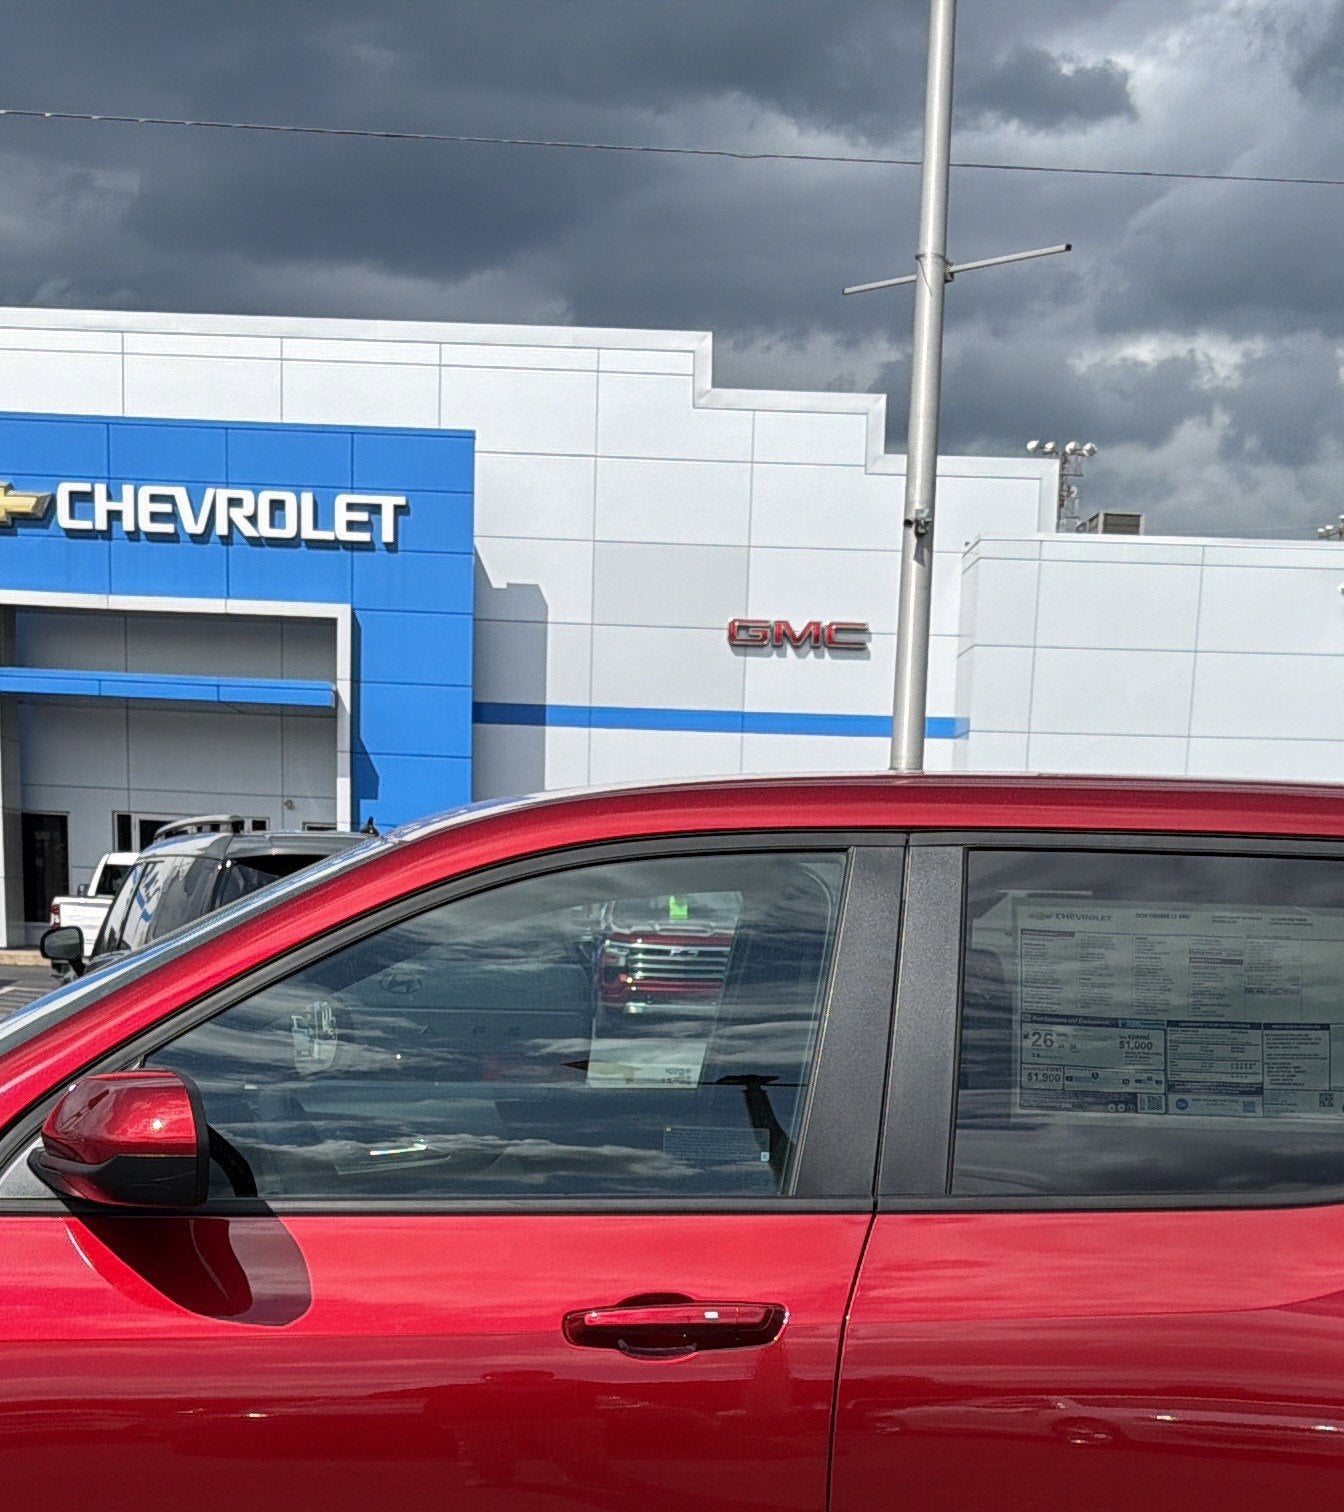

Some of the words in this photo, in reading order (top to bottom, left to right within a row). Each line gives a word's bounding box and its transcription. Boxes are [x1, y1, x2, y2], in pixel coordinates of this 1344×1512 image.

[56, 481, 408, 547] CHEVROLET
[728, 618, 869, 649] GMC
[1055, 912, 1113, 922] CHEVROLET
[1030, 1031, 1055, 1049] 26
[1118, 1040, 1154, 1050] $1,000
